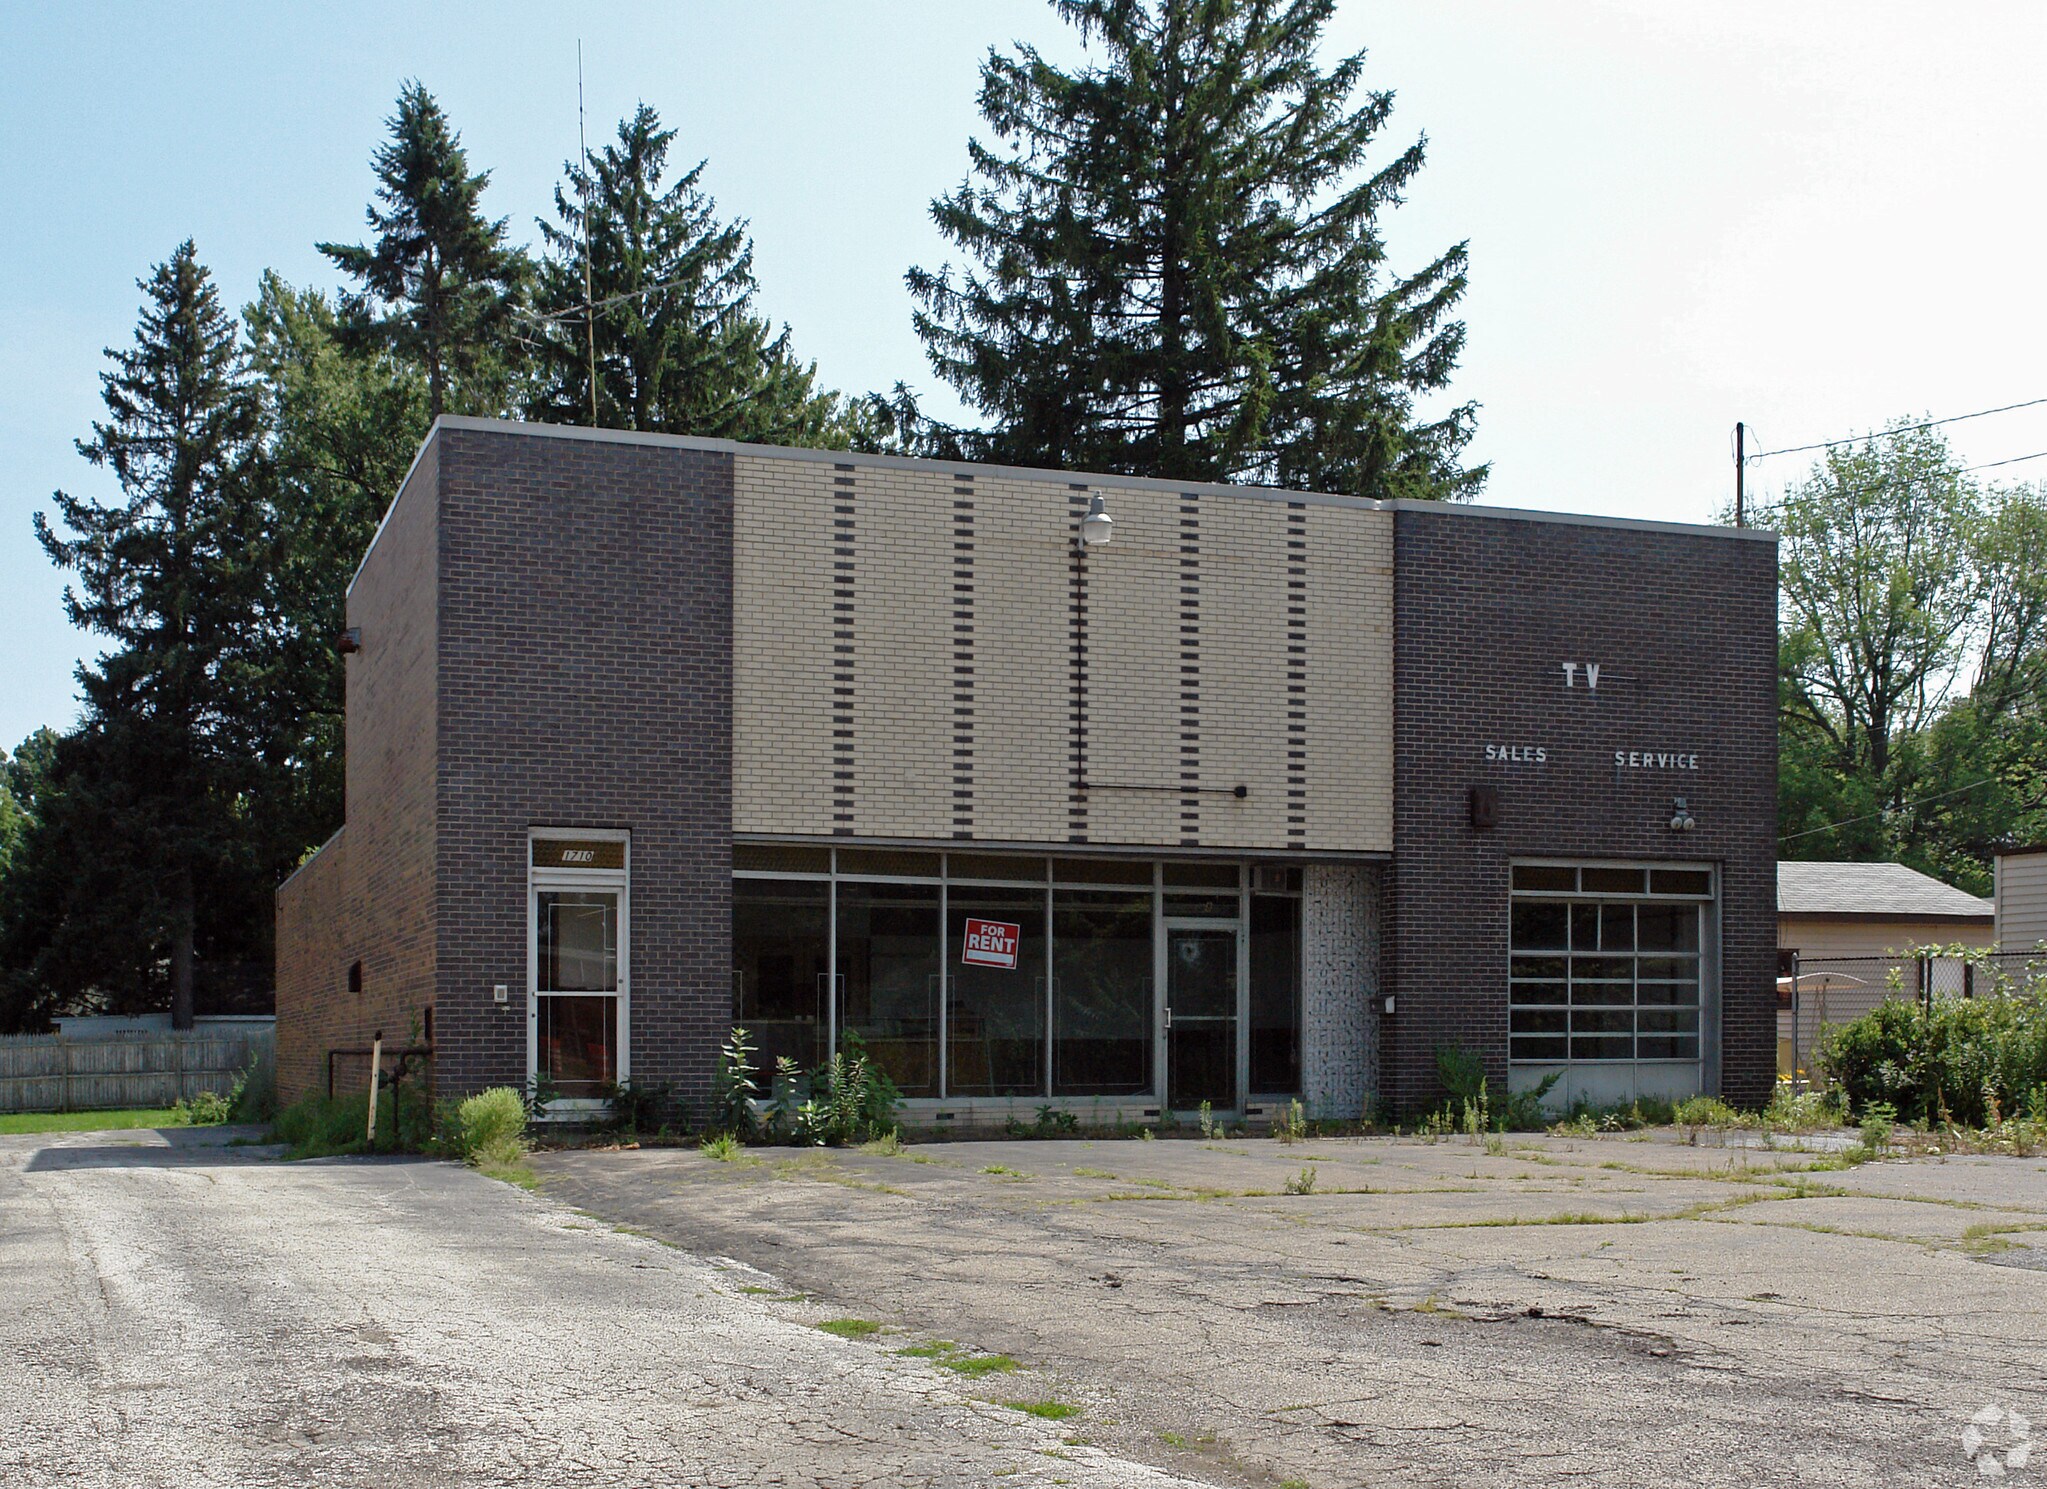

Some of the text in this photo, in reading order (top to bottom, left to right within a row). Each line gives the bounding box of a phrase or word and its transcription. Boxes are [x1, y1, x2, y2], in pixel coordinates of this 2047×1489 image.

[1562, 662, 1600, 688] TV
[1485, 744, 1699, 769] SALES SERVICE
[565, 851, 593, 861] 1710
[981, 924, 1005, 937] FOR
[968, 933, 1015, 953] RENT
